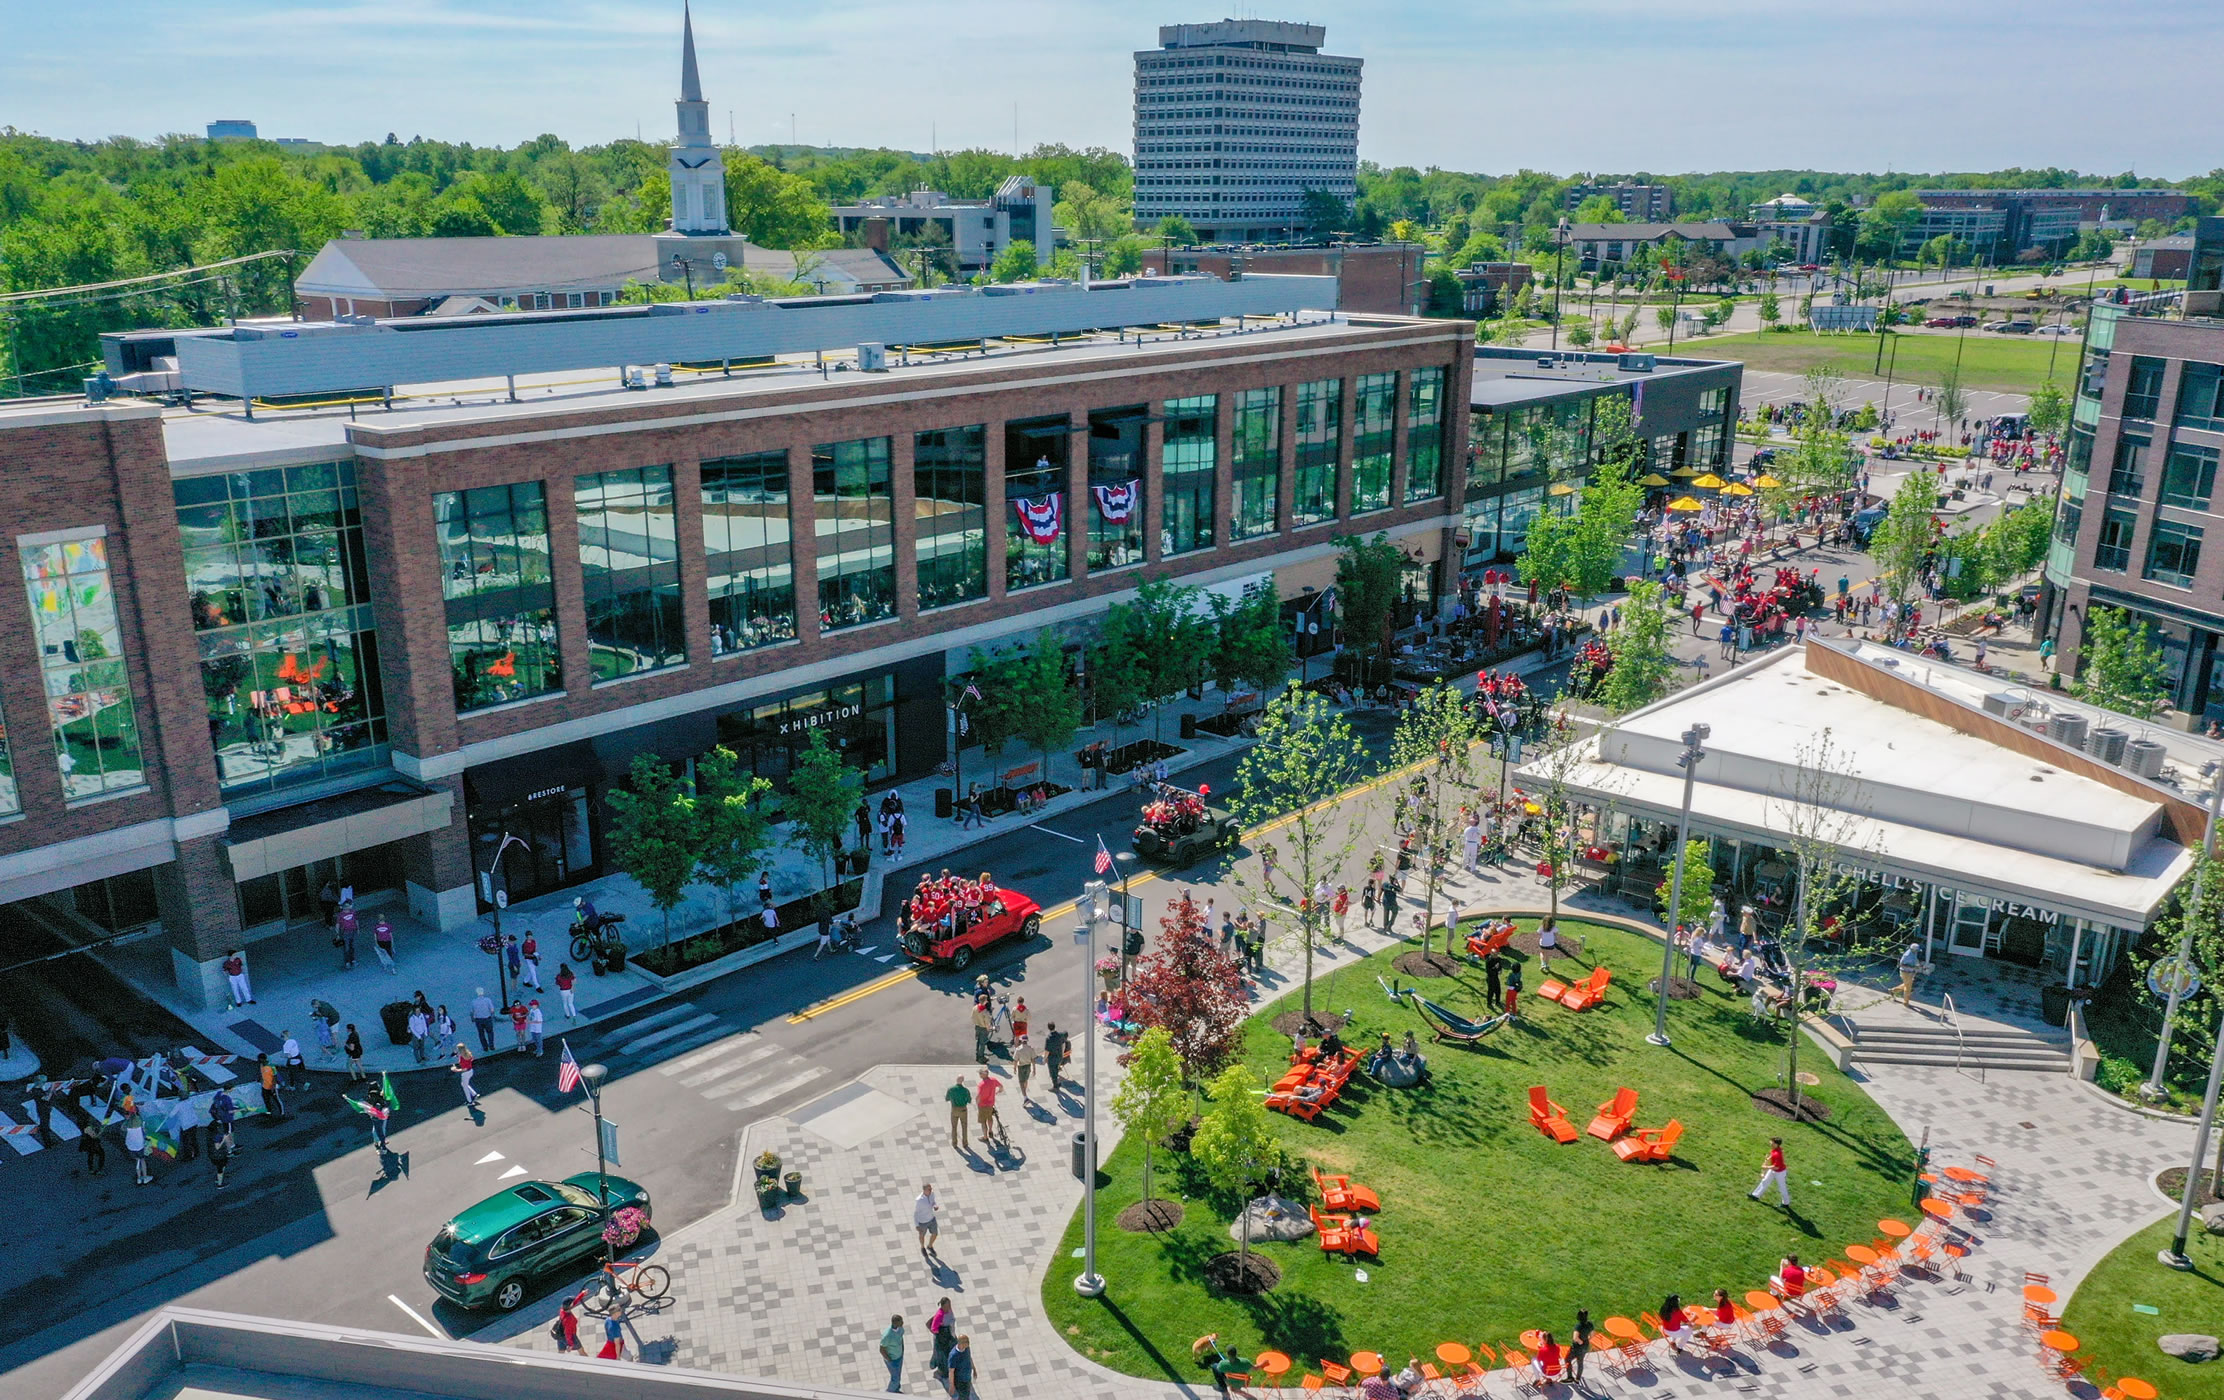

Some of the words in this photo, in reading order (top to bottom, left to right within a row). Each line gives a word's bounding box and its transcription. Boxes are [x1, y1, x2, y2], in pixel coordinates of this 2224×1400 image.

[533, 785, 565, 799] RESTORE
[1931, 884, 1967, 904] ICE
[1976, 895, 2059, 925] CREAM
